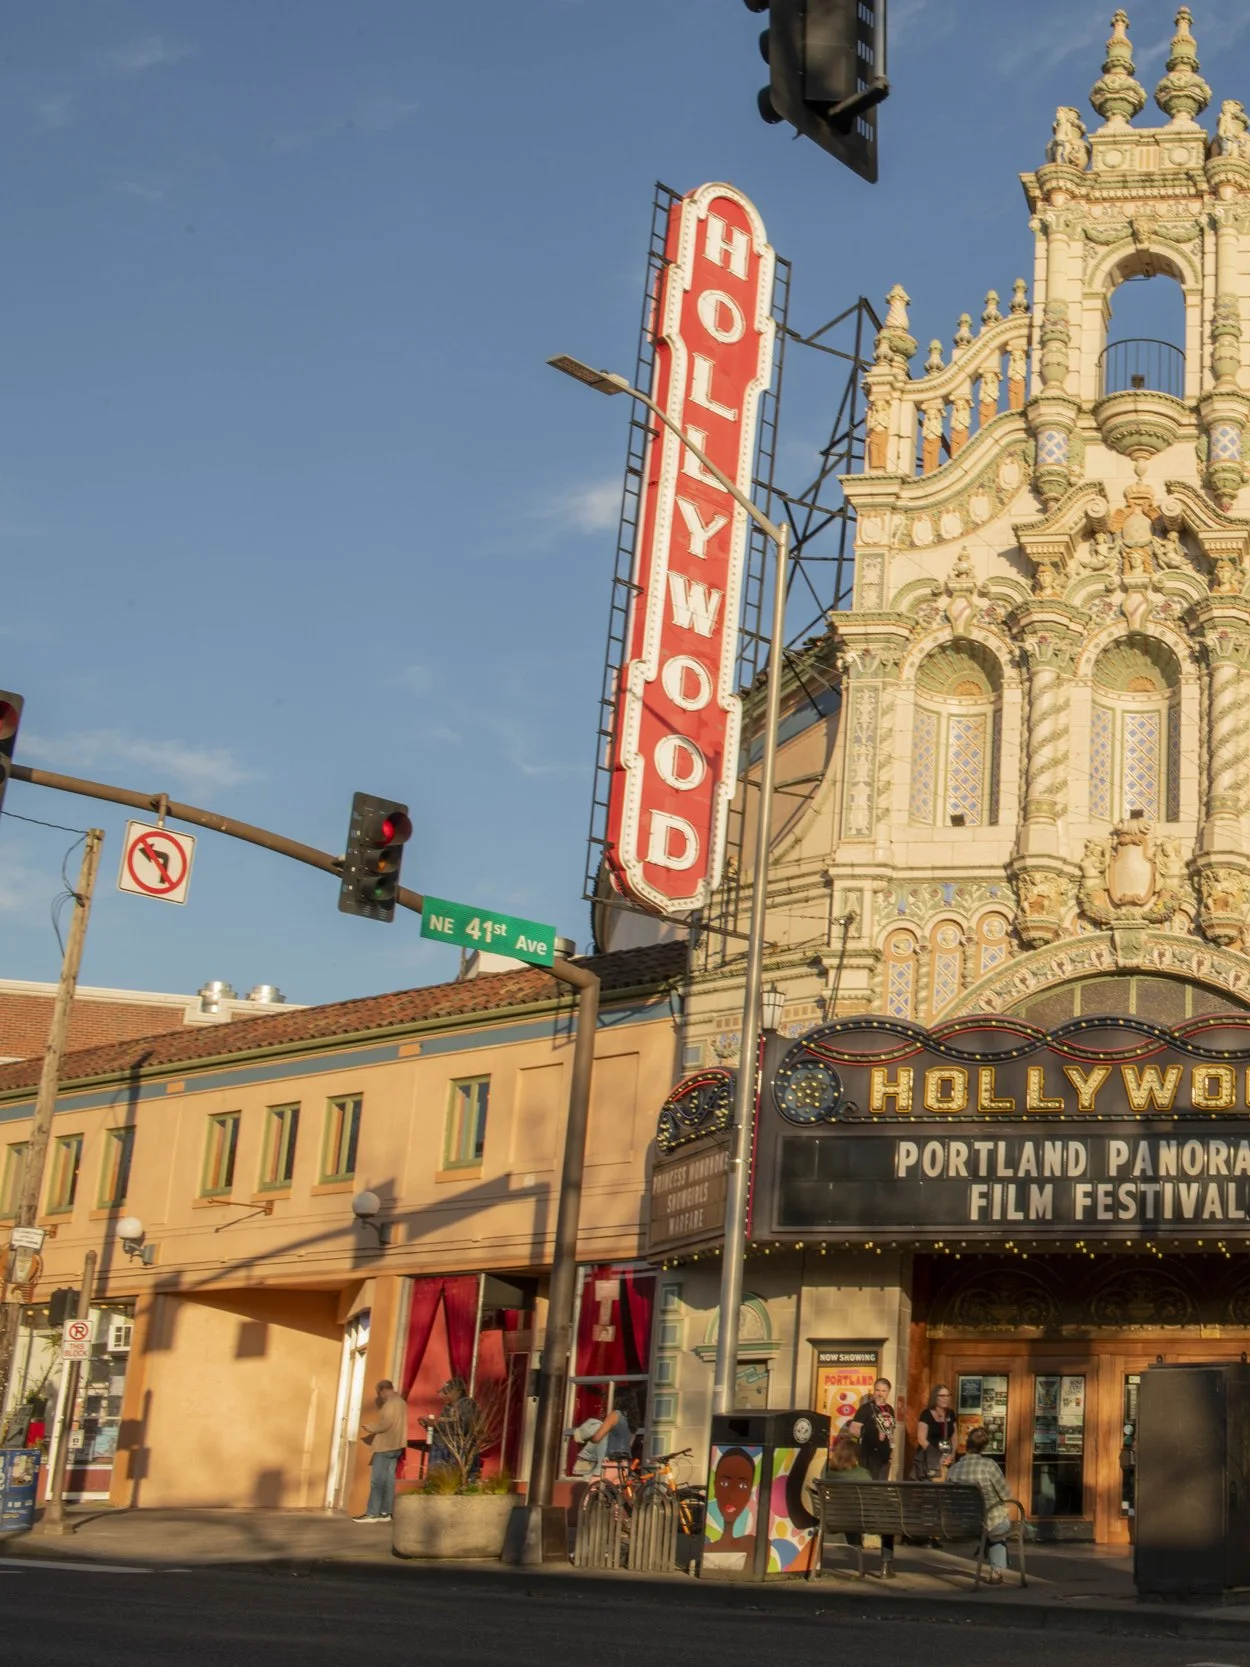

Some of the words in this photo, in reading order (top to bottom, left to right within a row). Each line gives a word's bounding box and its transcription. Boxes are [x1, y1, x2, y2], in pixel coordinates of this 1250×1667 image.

[643, 209, 752, 871] HOLLYWOOD
[429, 914, 455, 935] NE
[465, 917, 508, 943] 41st
[515, 935, 547, 956] Ave
[899, 1141, 1087, 1177] PORTLAND
[652, 1166, 687, 1196] PRINCESS
[667, 1182, 708, 1212] SHOWGIRLS
[970, 1183, 1053, 1220] FILM
[1074, 1182, 1246, 1220] FESTIVAL
[669, 1208, 703, 1236] WARFARE
[69, 1343, 84, 1351] THIS
[820, 1353, 838, 1361] NOW
[839, 1353, 876, 1361] SHOWING
[825, 1375, 874, 1386] PORTLAND
